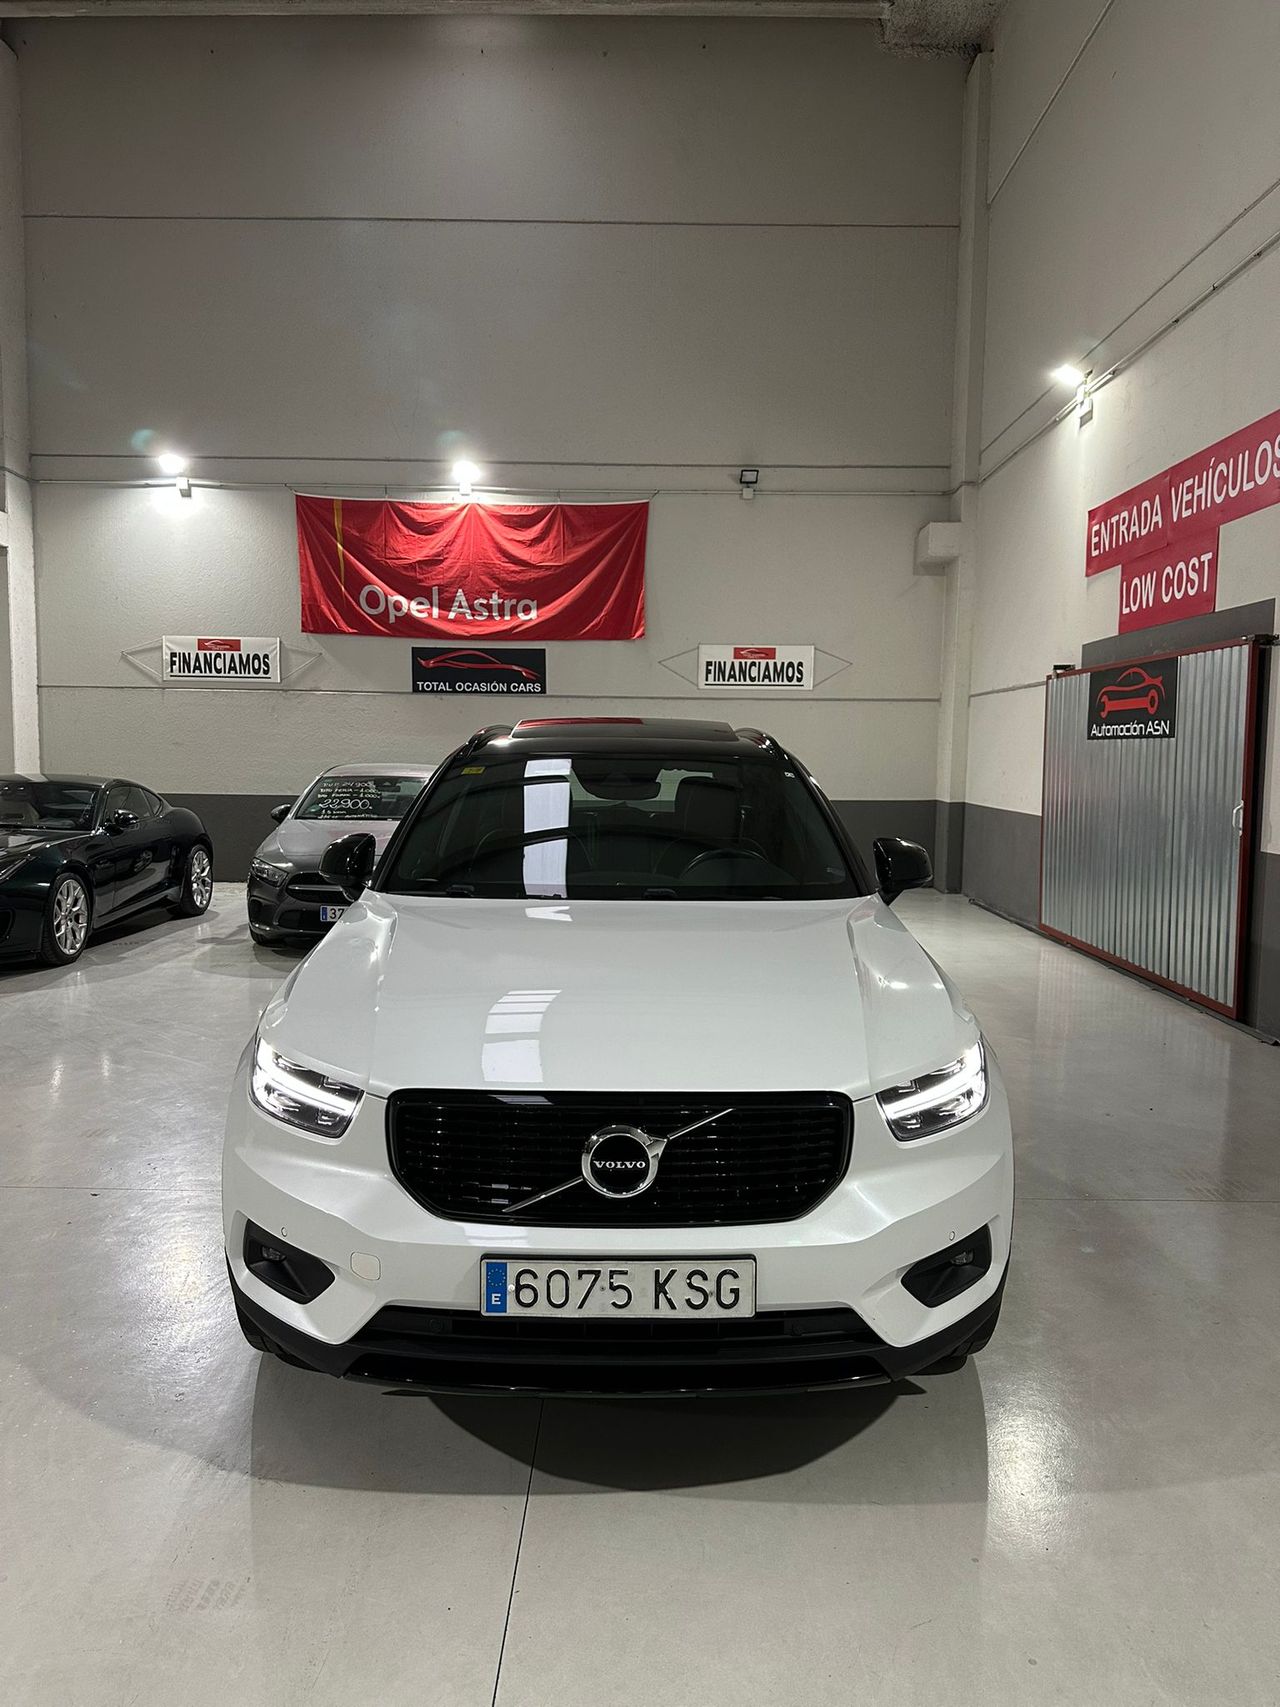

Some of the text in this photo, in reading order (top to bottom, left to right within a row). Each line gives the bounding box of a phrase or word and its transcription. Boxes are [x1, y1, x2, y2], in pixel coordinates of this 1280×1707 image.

[1091, 494, 1162, 557] ENTRADA
[1122, 551, 1213, 615] LOW COST
[359, 584, 538, 624] Opel Astra
[170, 652, 270, 675] FINANCIAMOS
[705, 661, 804, 683] FINANCIAMOS
[416, 680, 542, 693] TOTAL OCASIÓN CARS
[1090, 719, 1170, 737] Automoción ASN
[593, 1160, 646, 1169] VOLVO
[491, 1268, 740, 1311] E 6075 KSG
